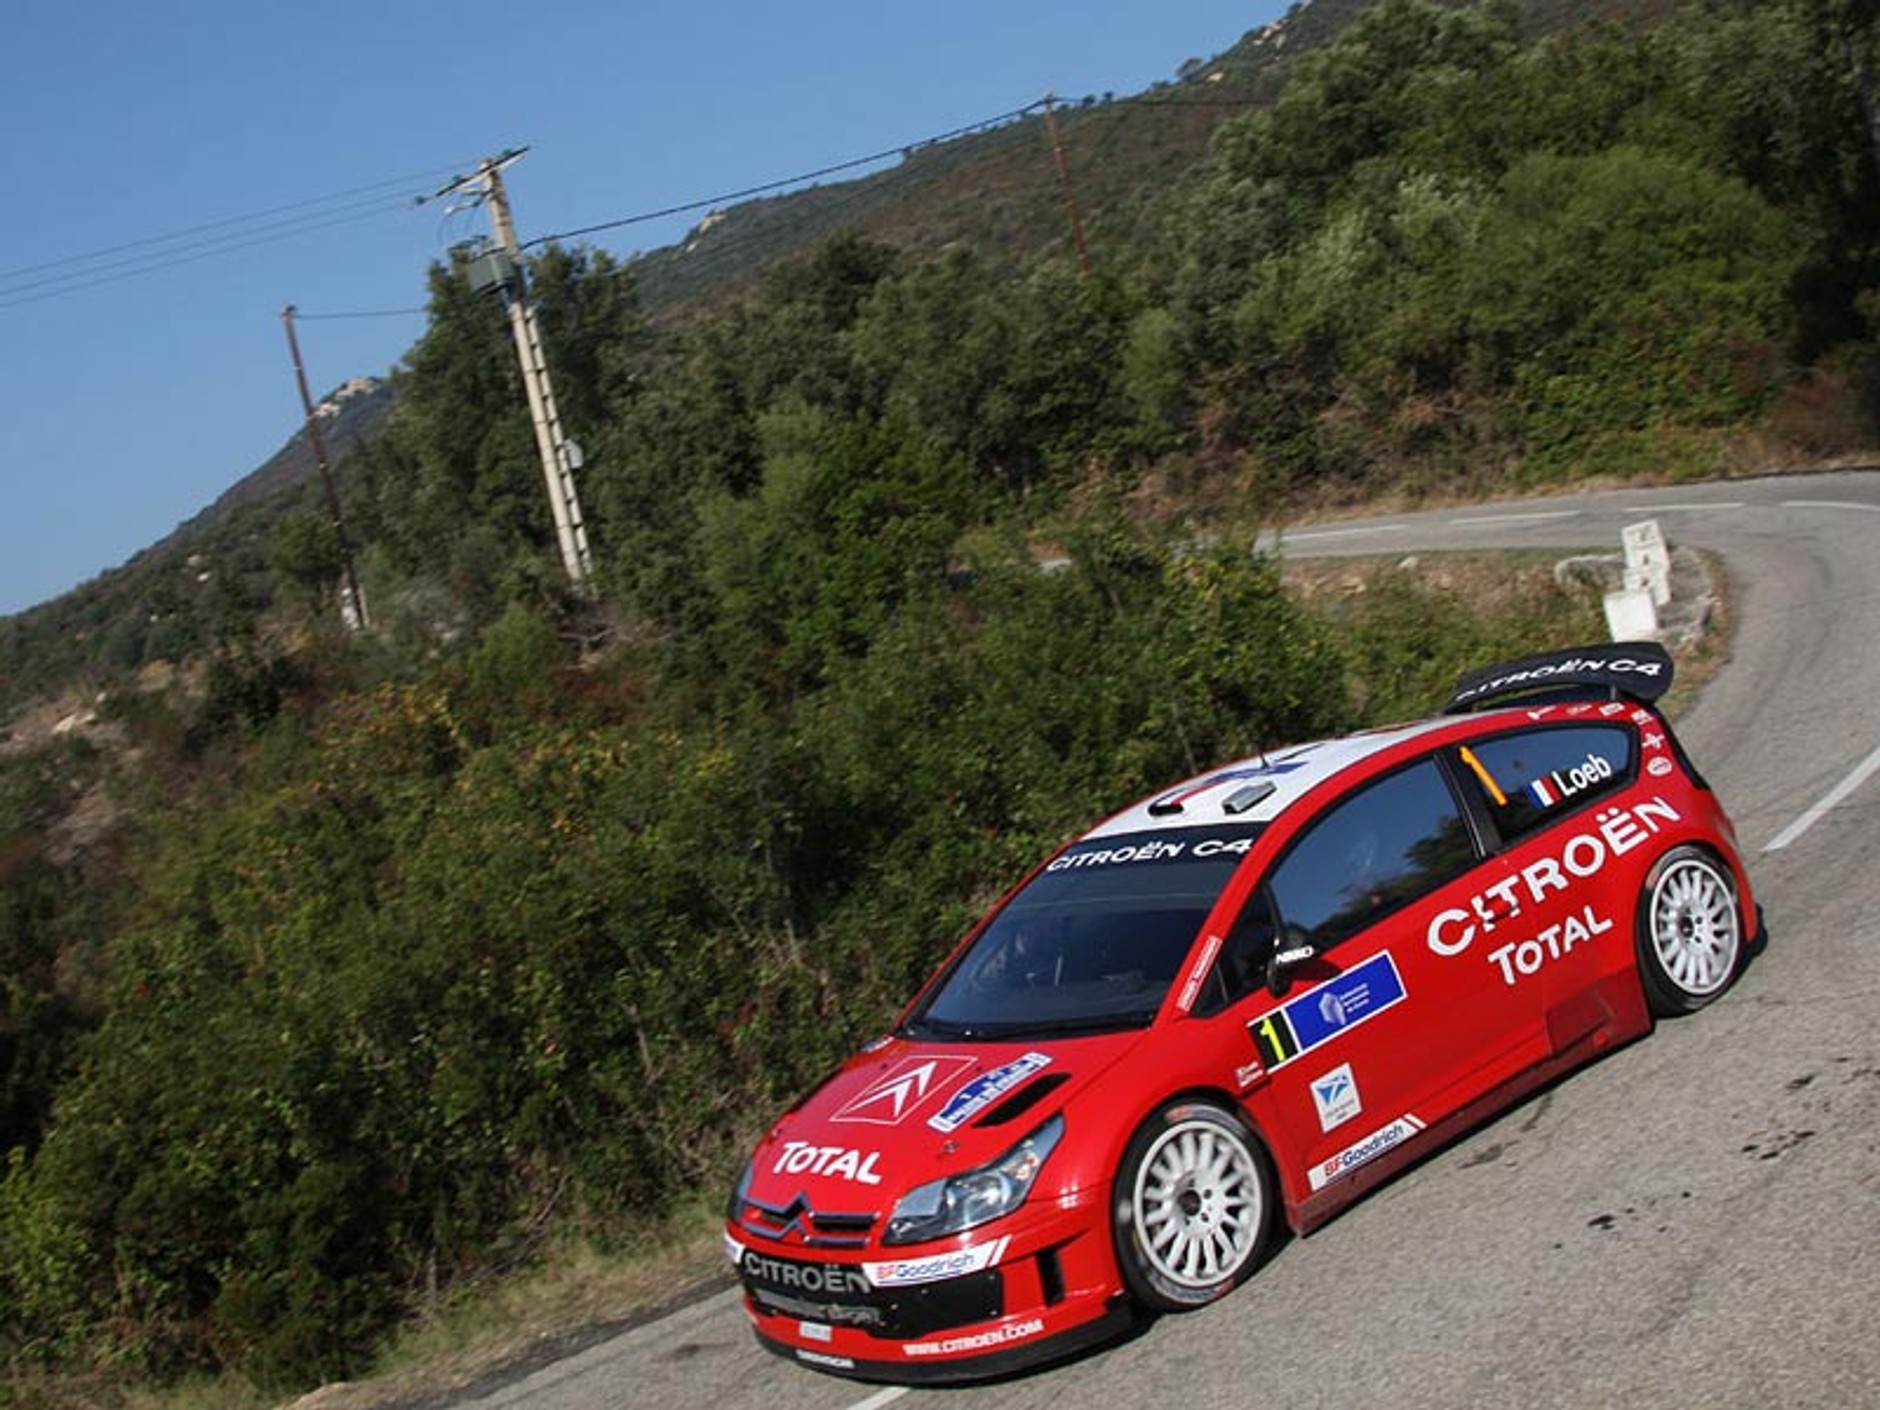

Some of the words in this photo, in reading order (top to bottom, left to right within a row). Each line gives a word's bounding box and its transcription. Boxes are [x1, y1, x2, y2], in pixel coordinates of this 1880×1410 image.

[1454, 657, 1606, 702] CITROËN
[1607, 658, 1664, 677] C4
[1459, 745, 1507, 806] 1
[1551, 753, 1612, 797] Loeb
[1046, 841, 1185, 872] CITROËN
[1191, 838, 1254, 855] C4
[1427, 795, 1682, 957] CITROËN
[1488, 905, 1614, 986] TOTAL
[1258, 1016, 1286, 1063] 1
[772, 1141, 883, 1185] TOTAL
[1323, 1123, 1404, 1177] BFGoodrich
[744, 1251, 871, 1294] CITROËN
[876, 1251, 975, 1279] BFGoodrich
